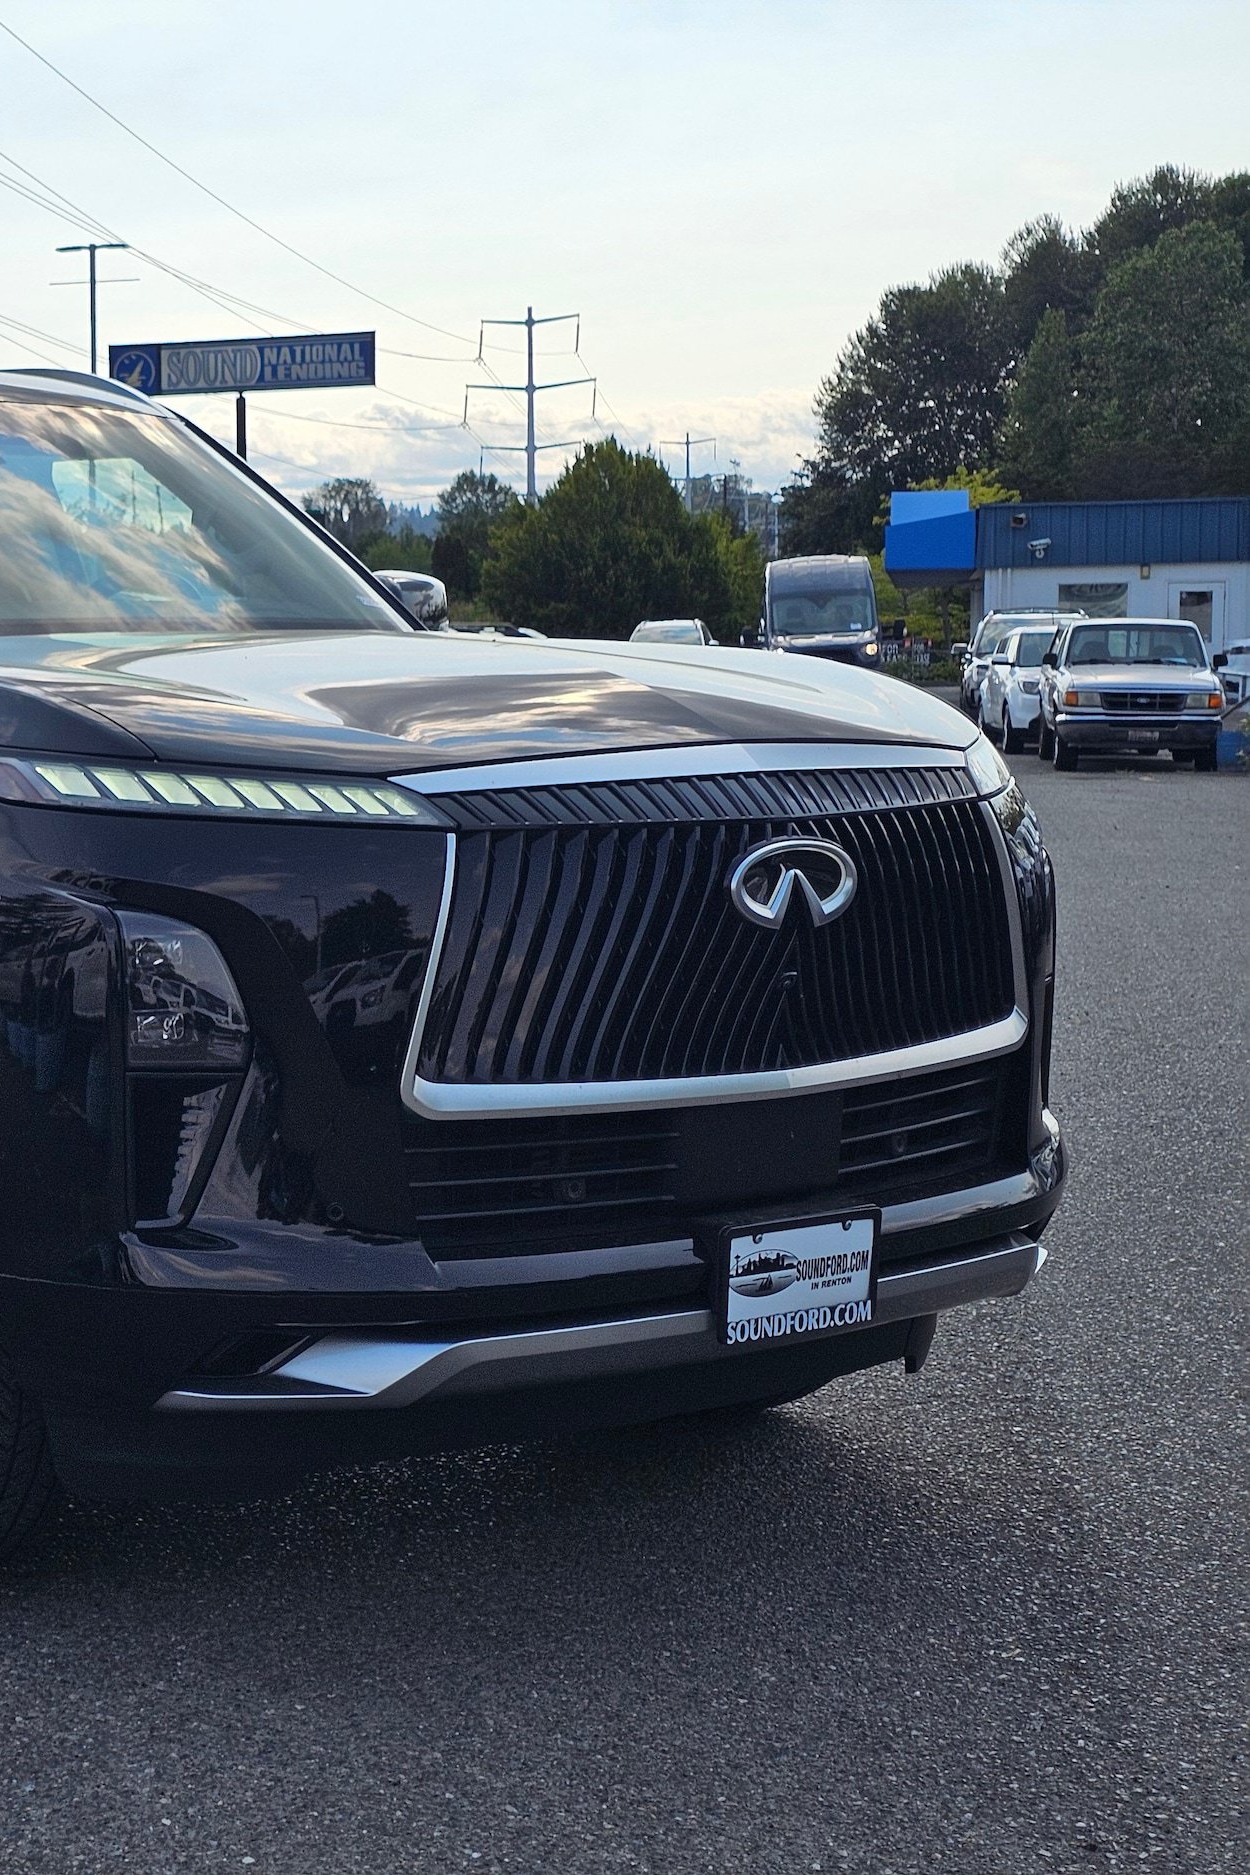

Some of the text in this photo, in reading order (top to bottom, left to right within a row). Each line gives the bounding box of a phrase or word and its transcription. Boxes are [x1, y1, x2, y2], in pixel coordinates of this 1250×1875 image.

[263, 342, 364, 365] NATIONAL
[166, 349, 259, 389] SOUND
[263, 362, 366, 382] LENDING
[796, 1250, 870, 1282] SOUNDFORD.COM
[811, 1276, 852, 1291] IN RENTON
[727, 1300, 872, 1345] SOUNDFORD.COM
